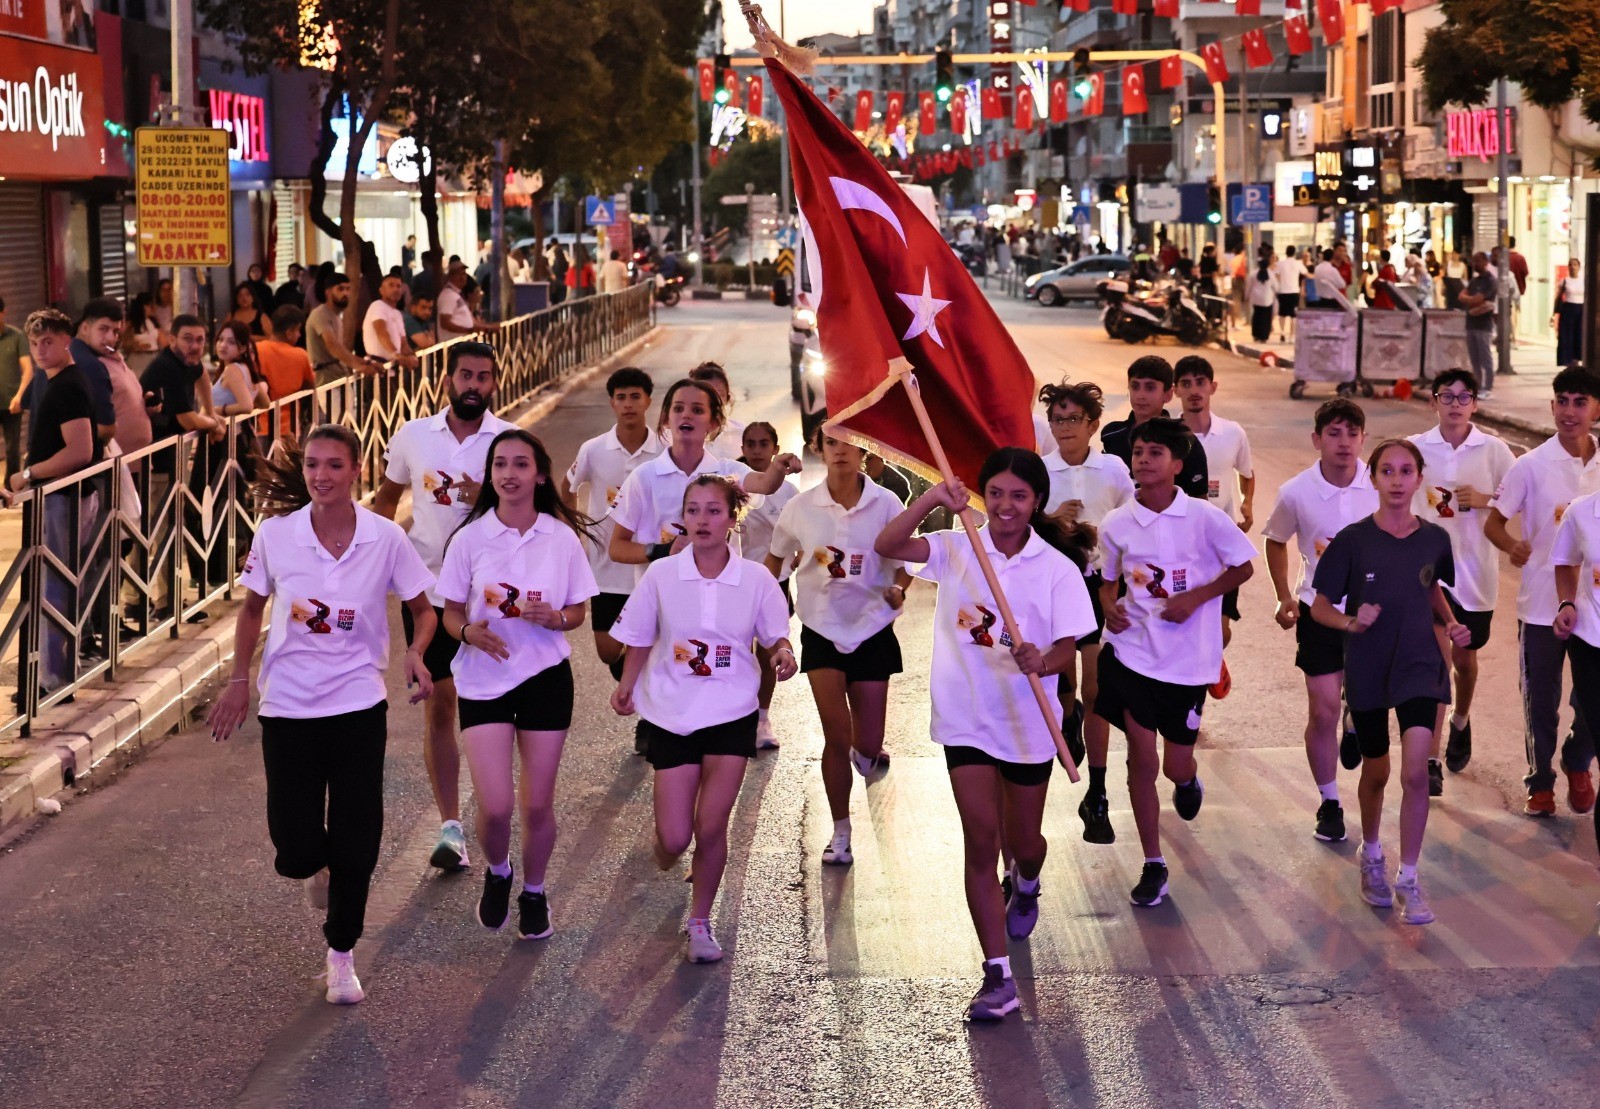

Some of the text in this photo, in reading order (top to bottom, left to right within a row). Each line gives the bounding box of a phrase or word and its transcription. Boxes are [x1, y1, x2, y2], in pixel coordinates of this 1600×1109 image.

[35, 66, 85, 152] Optik
[155, 133, 210, 143] UKOME'NİN
[195, 145, 225, 154] TARİH
[141, 157, 152, 166] VE
[195, 157, 226, 166] SAYILI
[148, 168, 218, 178] KARARI İLE BU
[141, 181, 225, 190] CADDE ÜZERİNDE
[141, 194, 225, 206] 08:00-20:00
[1245, 188, 1260, 209] P
[141, 209, 226, 218] SAATLERİ ARASINDA
[143, 220, 225, 229] YÜK İNDİRME VE
[159, 231, 209, 240] BİNDİRME
